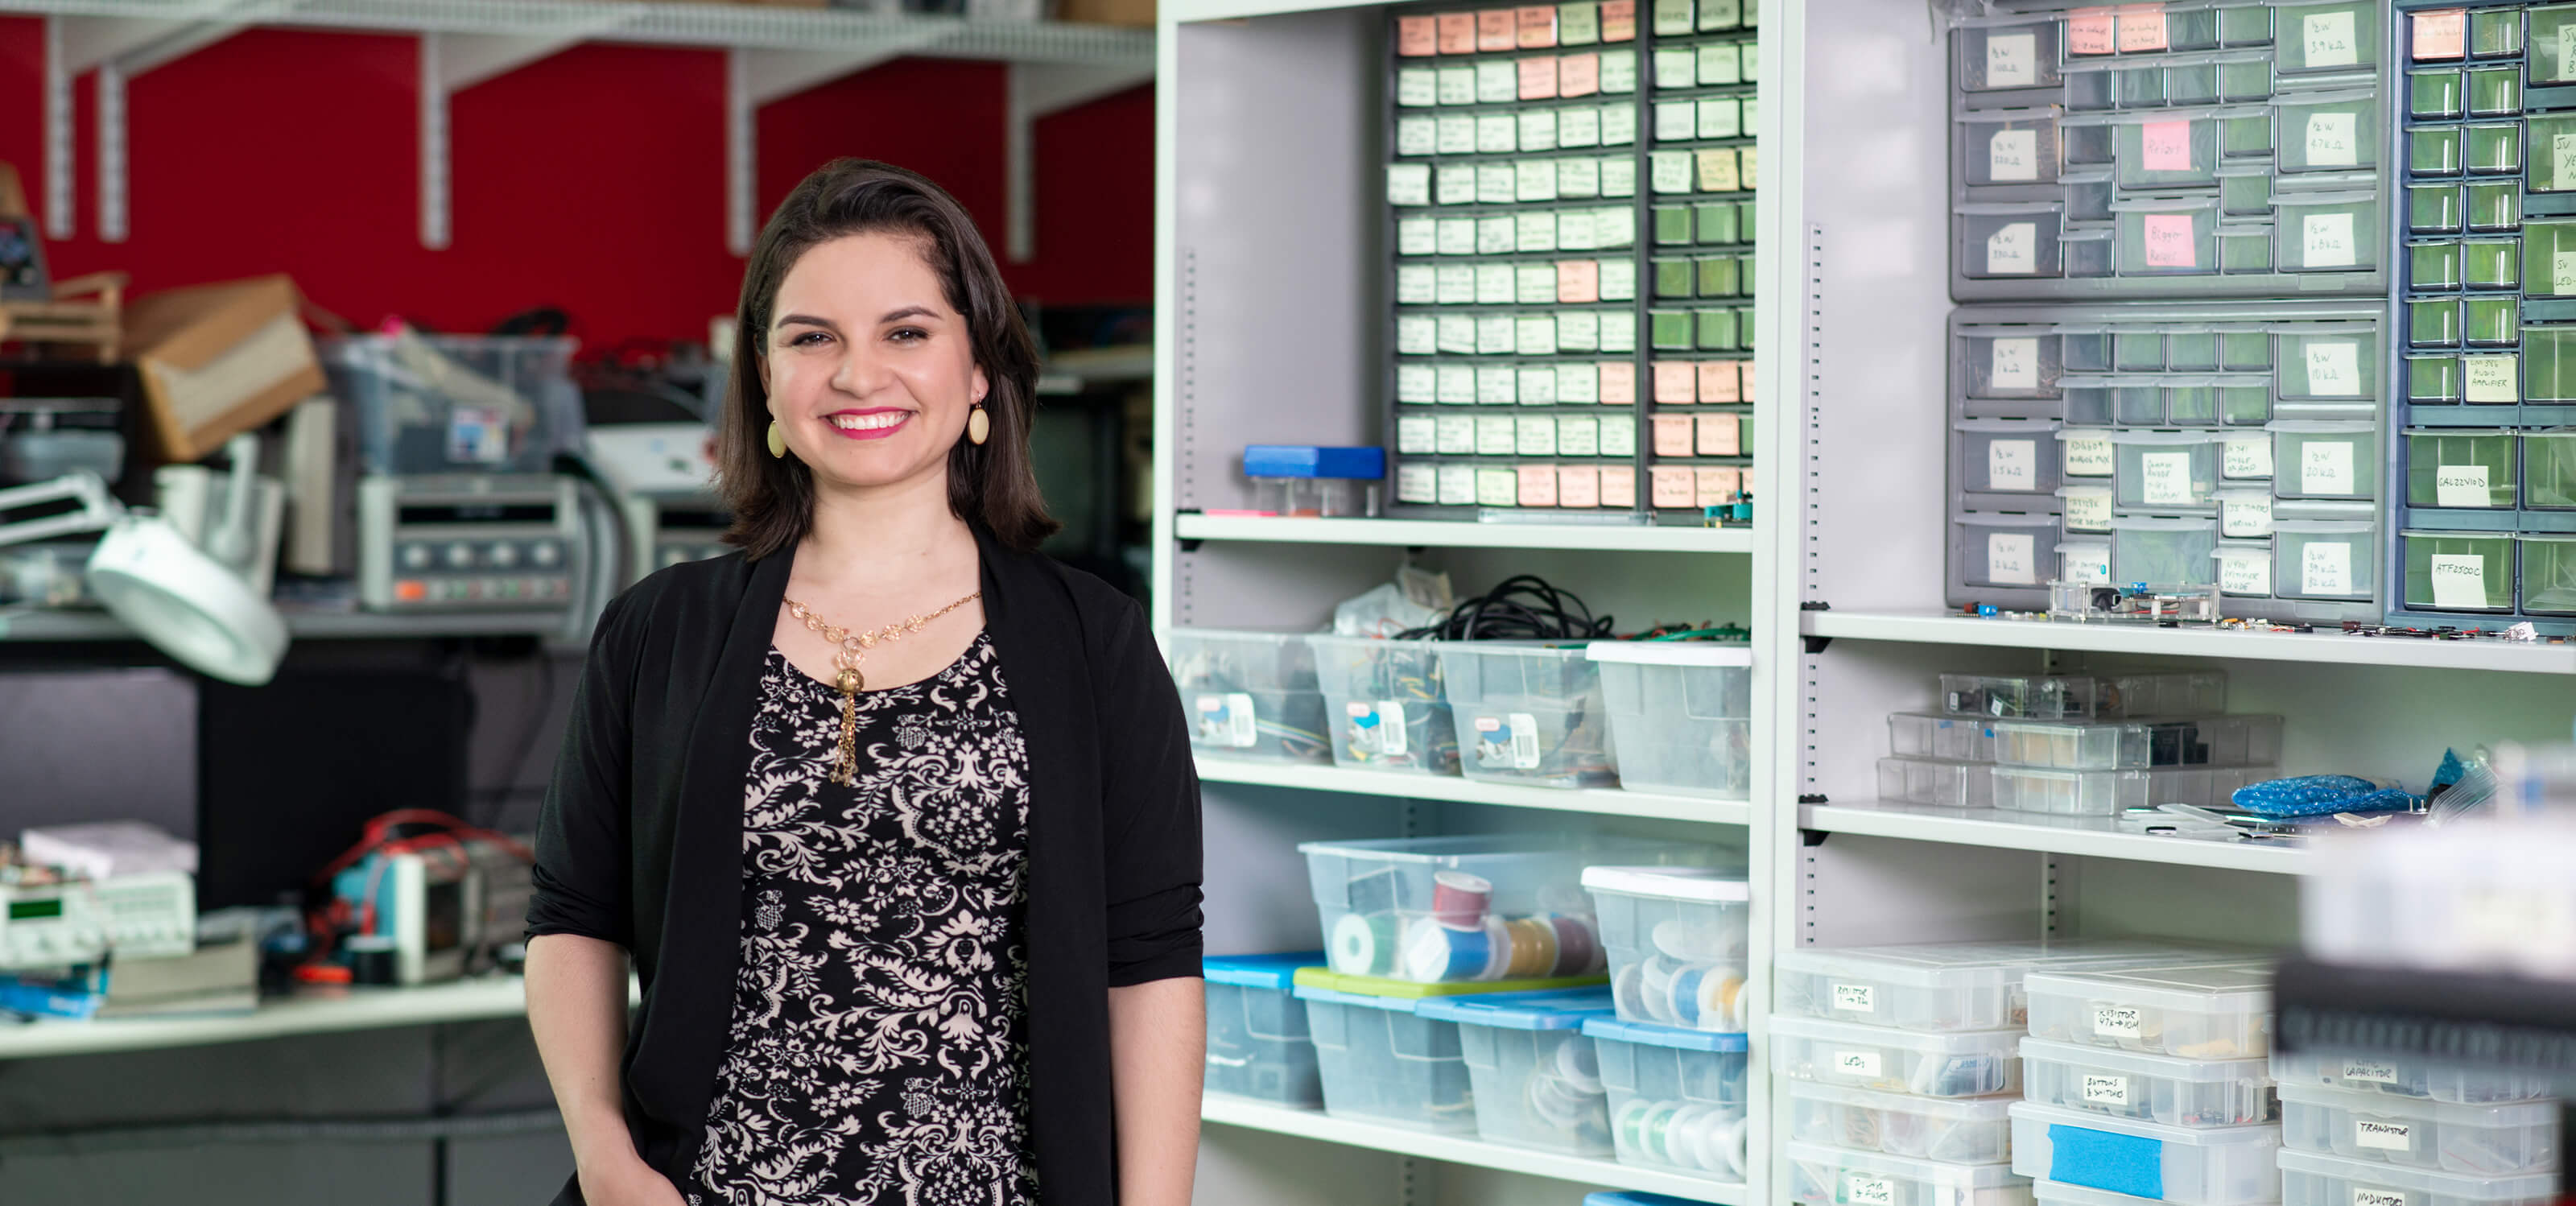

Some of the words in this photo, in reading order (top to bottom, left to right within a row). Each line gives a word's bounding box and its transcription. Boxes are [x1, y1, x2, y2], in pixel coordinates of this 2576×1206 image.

[2471, 378, 2508, 387] AMPLIFIER
[2438, 477, 2485, 487] GAL22V10D
[2435, 564, 2480, 576] ATF2500C
[2345, 1067, 2392, 1079] CAPACITOR
